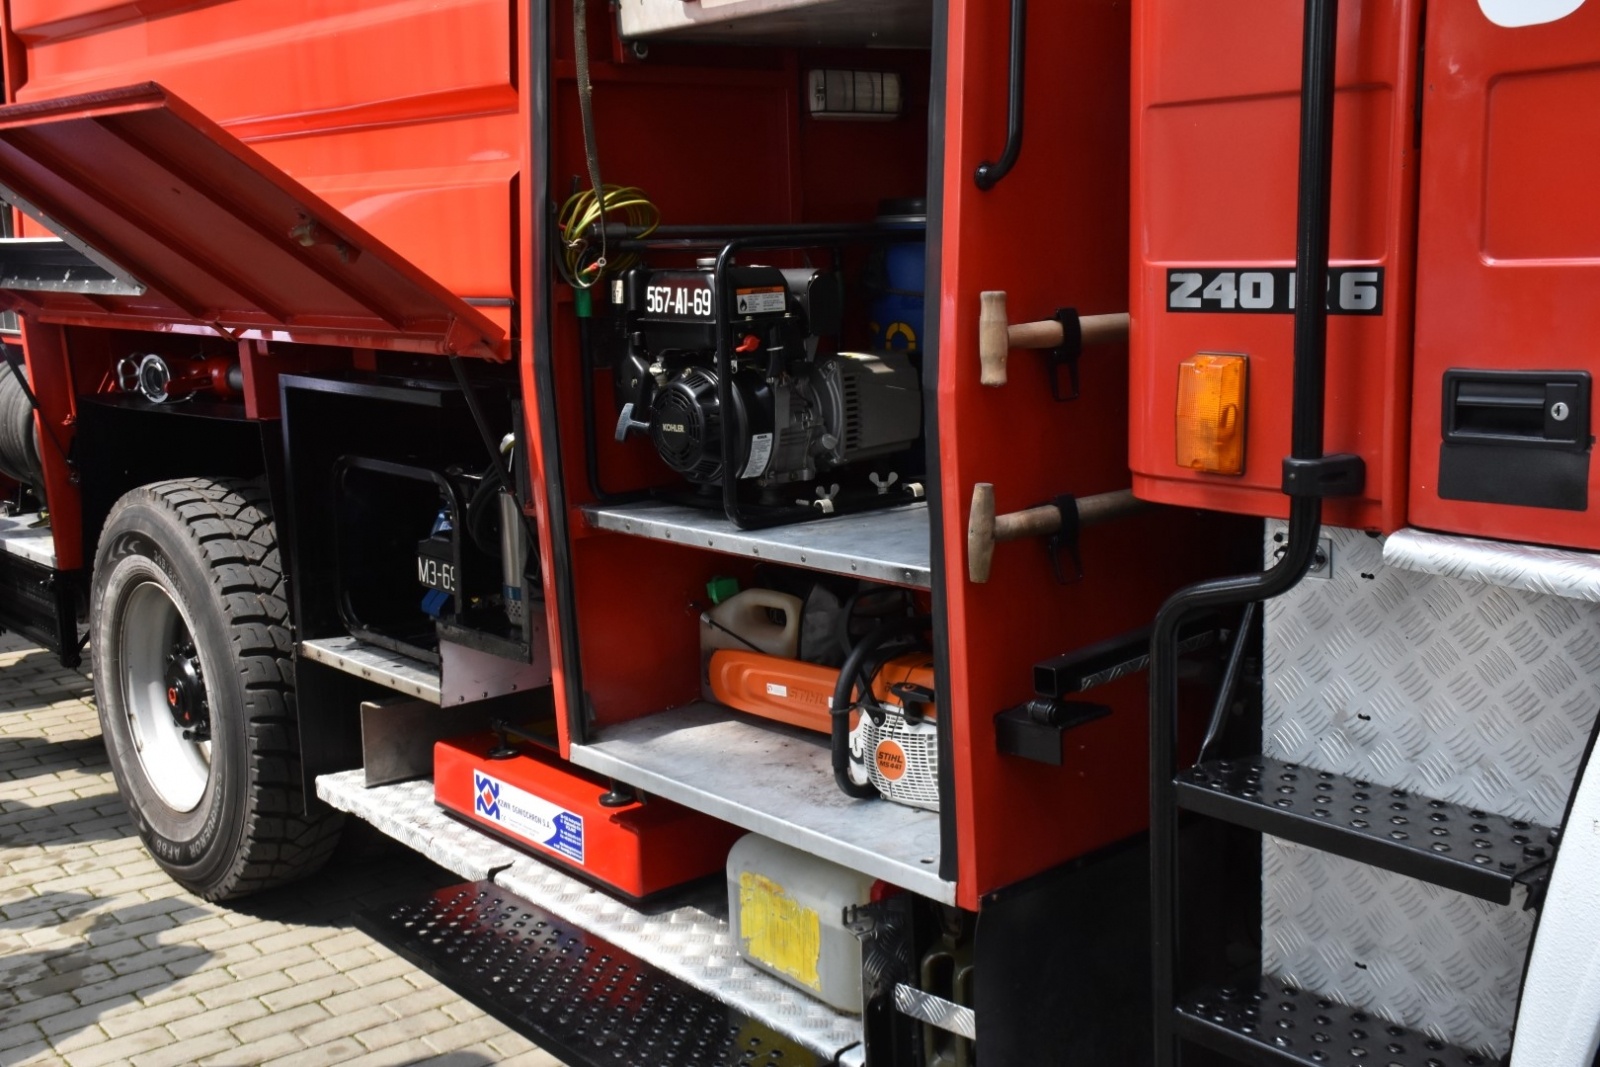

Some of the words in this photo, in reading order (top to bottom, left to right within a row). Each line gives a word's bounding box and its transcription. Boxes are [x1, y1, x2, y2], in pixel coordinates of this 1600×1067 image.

[1169, 272, 1274, 309] 240
[662, 423, 685, 433] KOHLER
[789, 687, 827, 706] STIHL
[878, 751, 903, 764] STIHL
[889, 762, 902, 770] 441
[188, 771, 223, 858] CONQUEROR
